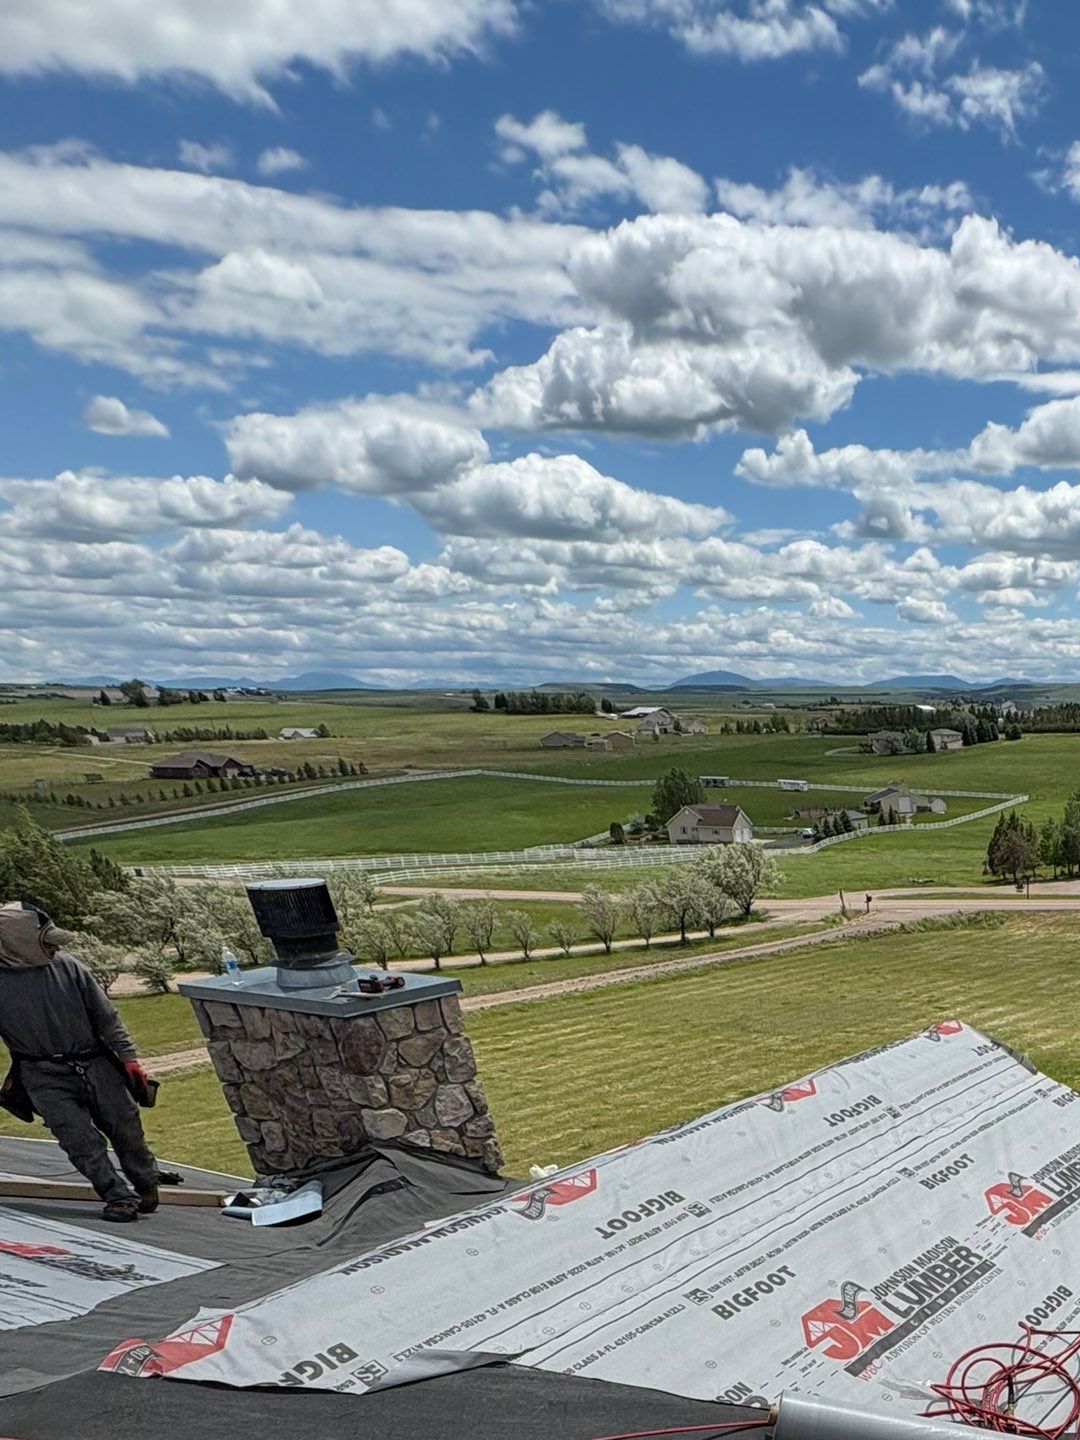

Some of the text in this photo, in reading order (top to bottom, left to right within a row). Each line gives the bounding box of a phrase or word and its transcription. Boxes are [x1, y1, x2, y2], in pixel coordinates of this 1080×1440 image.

[824, 1095, 882, 1127] BIGFOOT
[919, 1154, 974, 1189] BIGFOOT
[596, 1191, 684, 1239] BIGFOOT
[870, 1236, 959, 1300] JOHNSON MADISON
[879, 1243, 985, 1317] LUMBER
[712, 1266, 795, 1319] BIGFOOT
[1025, 1285, 1073, 1330] BIGFOO
